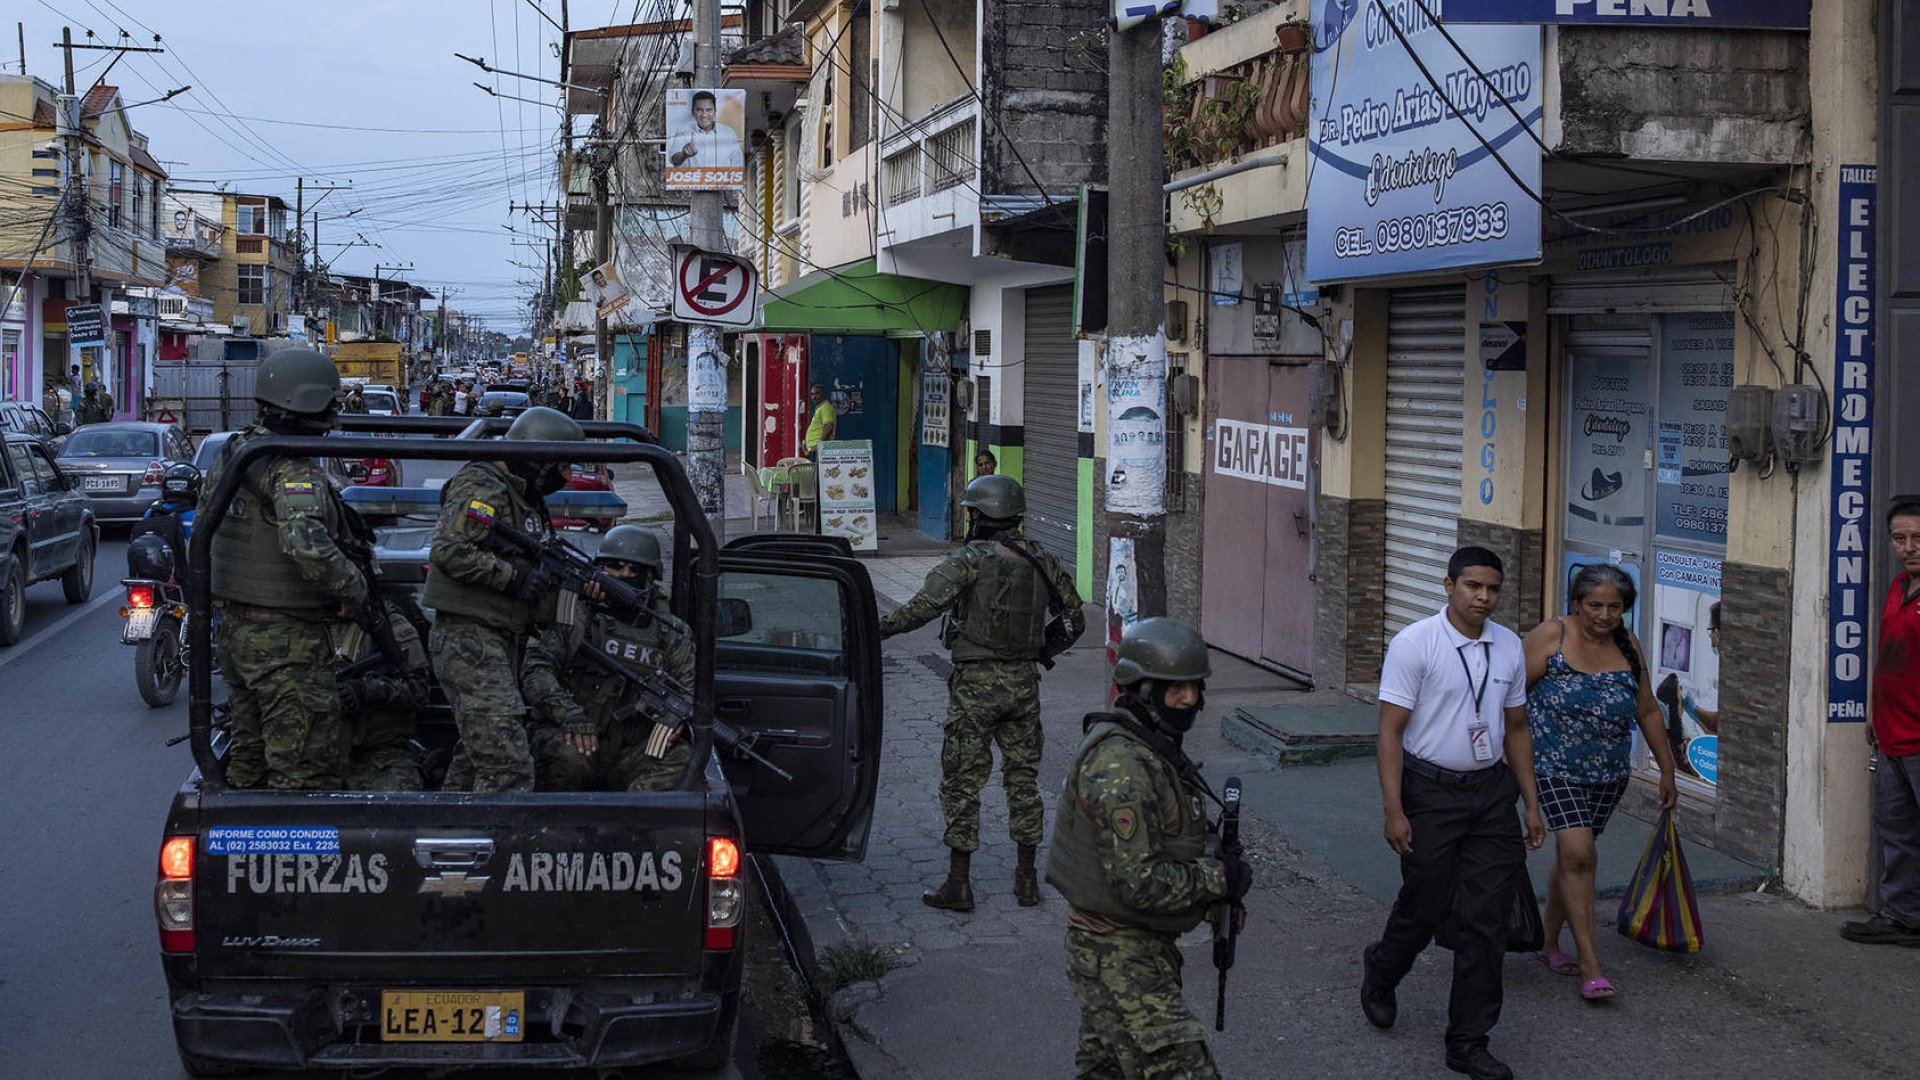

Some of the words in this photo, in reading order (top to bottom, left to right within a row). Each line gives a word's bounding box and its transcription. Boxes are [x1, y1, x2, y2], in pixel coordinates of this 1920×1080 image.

[1341, 97, 1390, 146] Pedro
[1392, 82, 1442, 133] Arias
[1446, 61, 1531, 122] Moyano
[666, 169, 701, 183] JOSÉ
[704, 170, 744, 183] SOLÍS
[1364, 146, 1459, 207] Odontologo
[1335, 226, 1373, 258] CEL.
[1376, 201, 1509, 253] 0980137933
[1218, 425, 1306, 483] GARAGE
[1828, 699, 1866, 718] PEÑA
[209, 829, 255, 839] INFORME
[256, 829, 288, 839] COMO
[209, 841, 224, 850] AL
[226, 840, 247, 852] (02)
[248, 841, 291, 851] 2583032
[293, 840, 313, 850] Ext.
[227, 852, 390, 895] FUERZAS
[501, 849, 683, 893] ARMADAS
[426, 993, 481, 1005] ECUADOR
